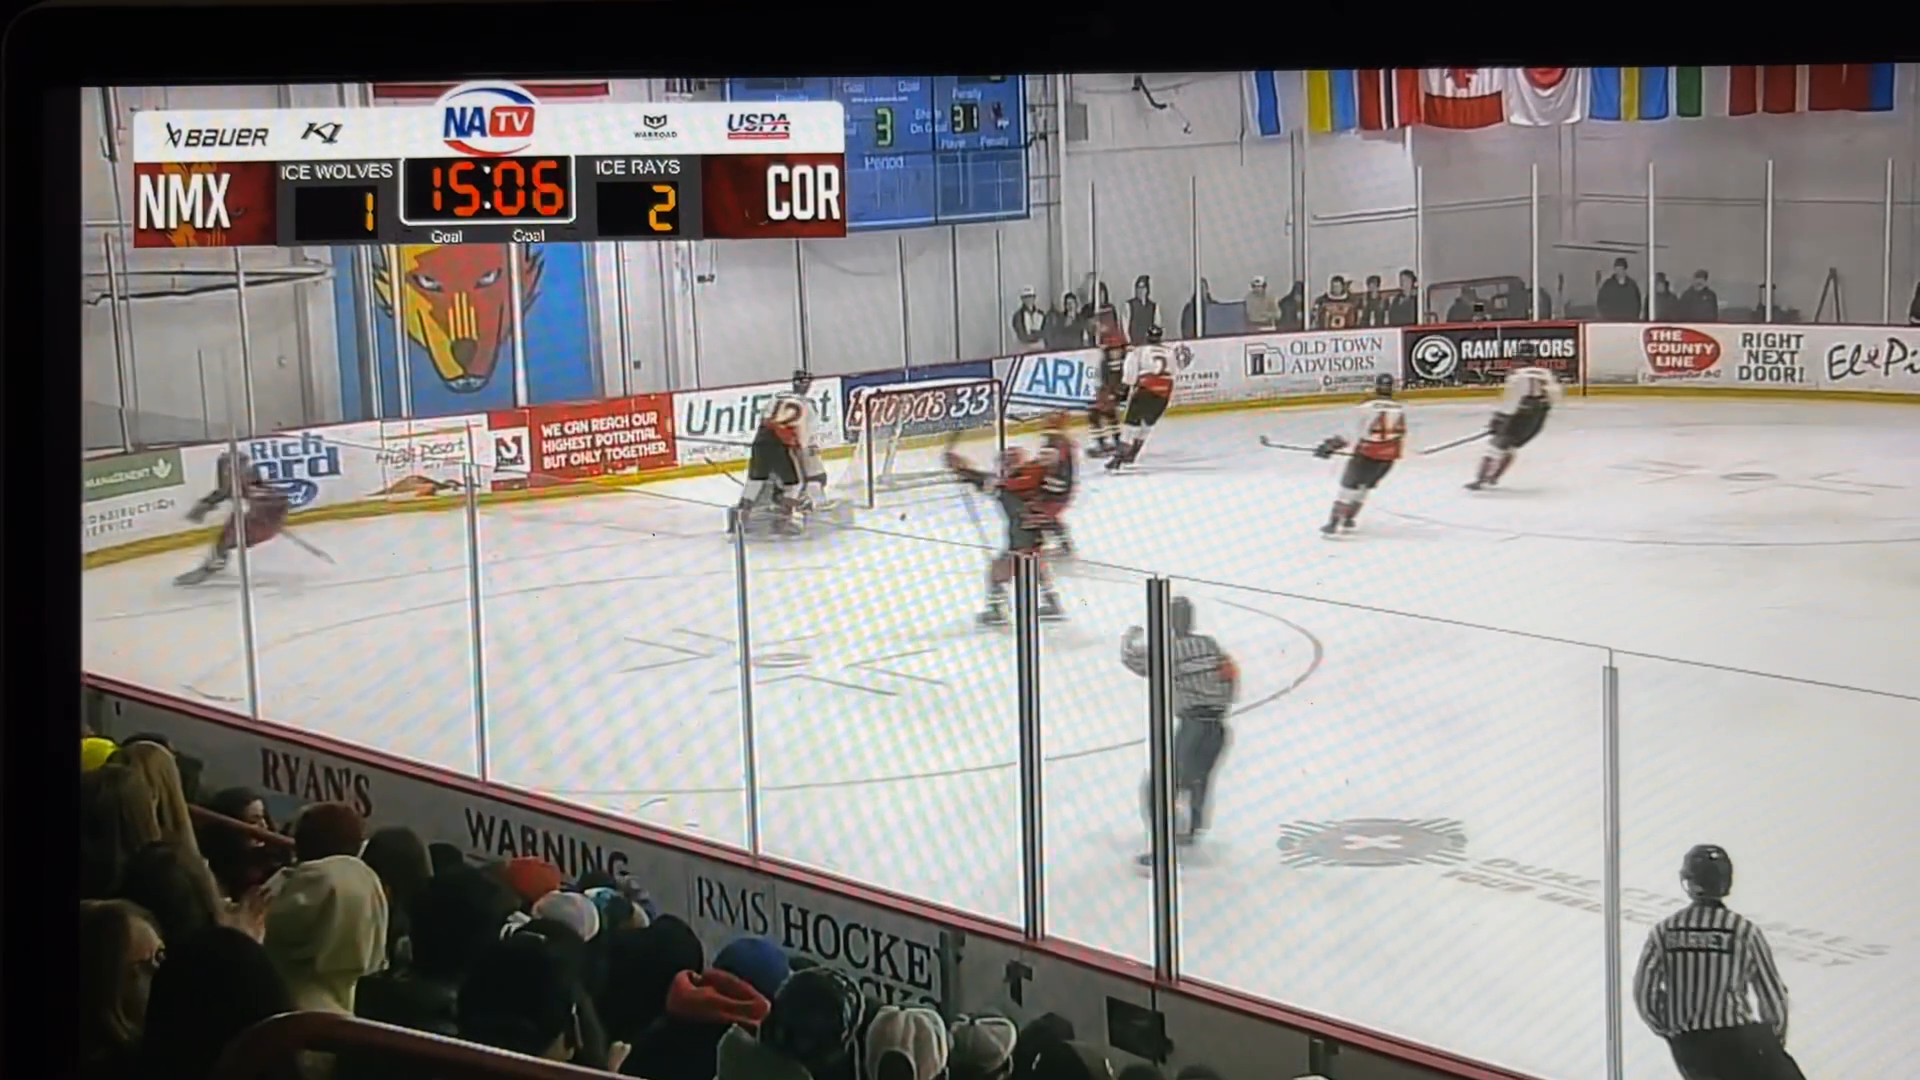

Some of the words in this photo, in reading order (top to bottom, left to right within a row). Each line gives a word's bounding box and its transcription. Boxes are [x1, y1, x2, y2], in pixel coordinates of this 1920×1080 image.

[877, 108, 892, 146] 3
[953, 105, 978, 132] 31
[184, 127, 269, 147] BAUER
[281, 165, 311, 180] ICE
[315, 164, 393, 180] WOLVES
[595, 161, 628, 176] ICE
[631, 160, 681, 175] RAYS
[139, 173, 231, 230] NMX
[432, 160, 564, 217] 15:06
[766, 164, 841, 222] COR
[364, 192, 374, 232] 1
[648, 184, 676, 232] 2
[1290, 339, 1327, 357] OLD
[1334, 335, 1383, 352] TOWN
[1461, 339, 1500, 359] RAM
[1503, 338, 1576, 359] MTORS
[1647, 342, 1716, 355] COUNTY
[1650, 329, 1683, 341] THE
[1741, 332, 1804, 350] RIGHT
[1290, 355, 1375, 375] ADVISORS
[1655, 356, 1695, 368] LINE
[1745, 349, 1799, 366] NEXT
[1026, 357, 1084, 397] ARI
[1738, 365, 1805, 383] DOOR!
[686, 388, 831, 436] UniFt
[950, 384, 991, 418] 33
[541, 423, 561, 438] WE
[563, 419, 589, 436] CAN
[591, 415, 630, 433] REACH
[631, 411, 658, 427] OUR
[250, 432, 324, 460] Rich
[541, 438, 592, 454] HIGHEST
[542, 454, 567, 470] BUT
[570, 449, 602, 467] ONLY
[605, 442, 670, 461] TOGETHER.
[261, 747, 372, 819] RYAN'S
[465, 806, 629, 878] WARNING
[697, 875, 769, 936] RMS
